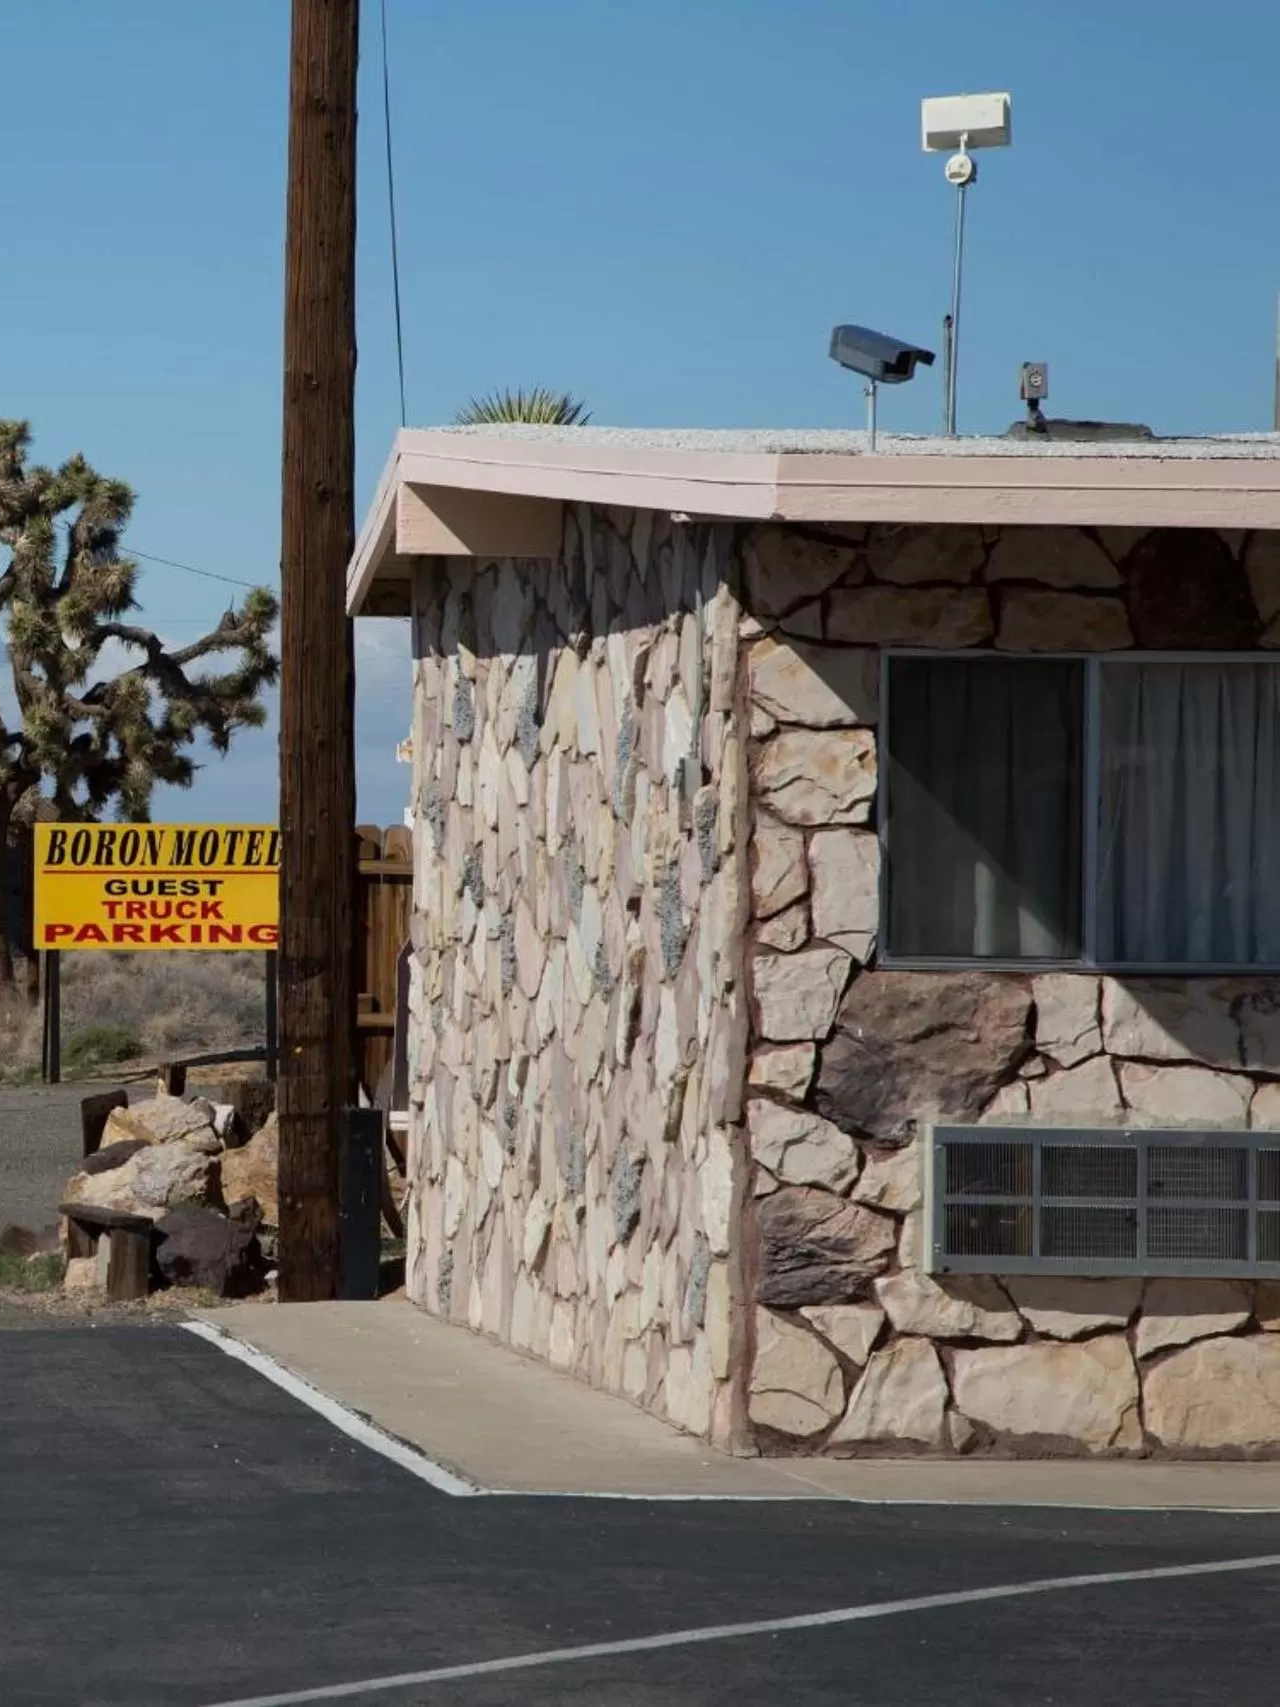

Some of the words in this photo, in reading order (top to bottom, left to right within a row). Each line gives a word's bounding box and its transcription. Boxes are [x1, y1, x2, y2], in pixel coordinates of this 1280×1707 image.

[45, 829, 165, 866] BORON
[104, 879, 224, 896] GUEST
[102, 901, 224, 919] TRUCK
[44, 924, 280, 943] PARKING
